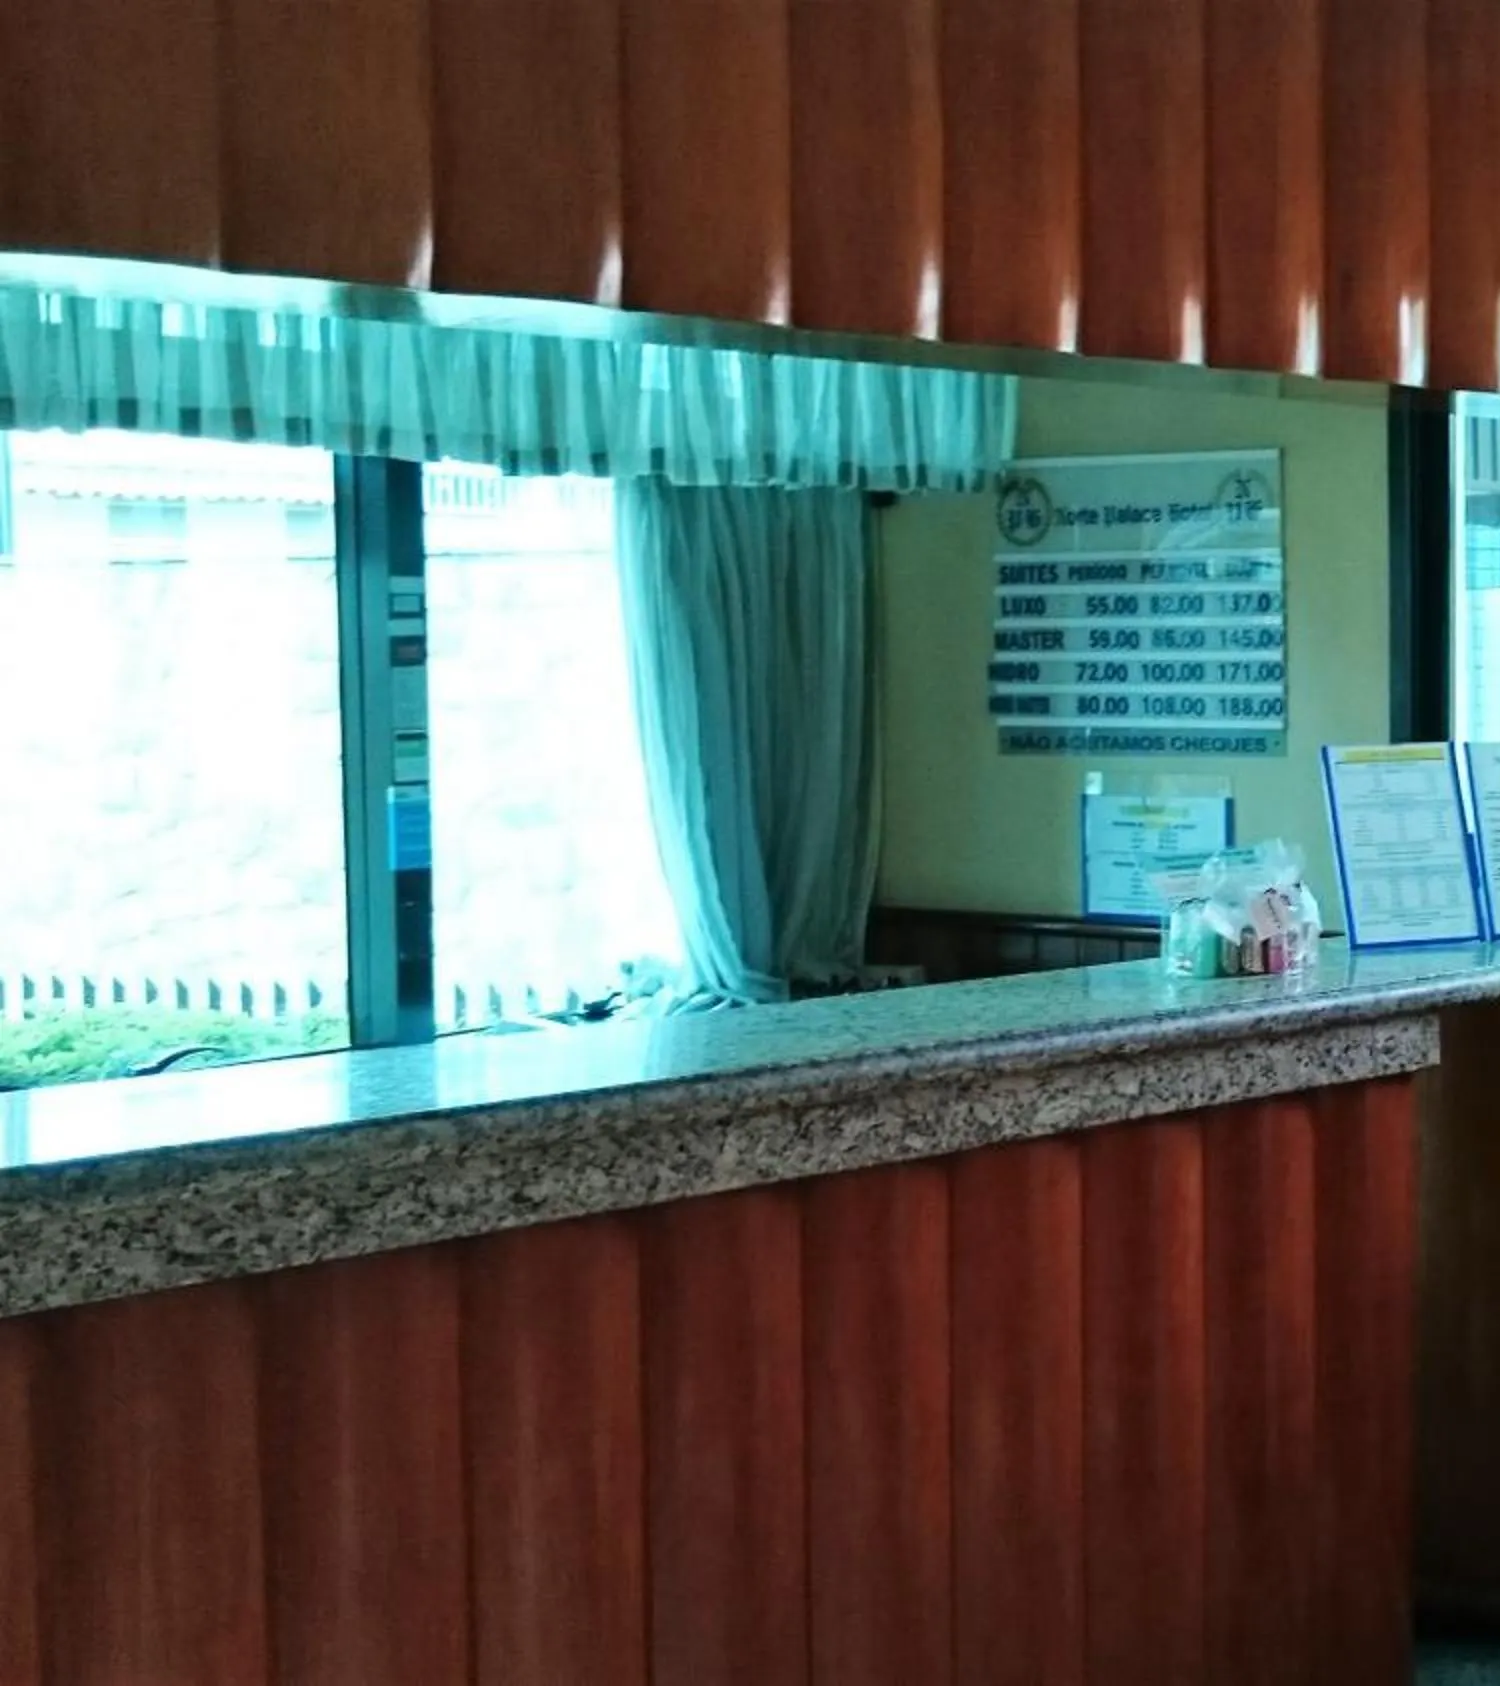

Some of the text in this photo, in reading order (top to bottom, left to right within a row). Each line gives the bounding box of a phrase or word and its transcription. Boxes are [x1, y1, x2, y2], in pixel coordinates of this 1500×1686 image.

[1001, 595, 1046, 618] LUXO
[994, 629, 1065, 652] MASTER
[1169, 734, 1268, 752] CHEQUES
